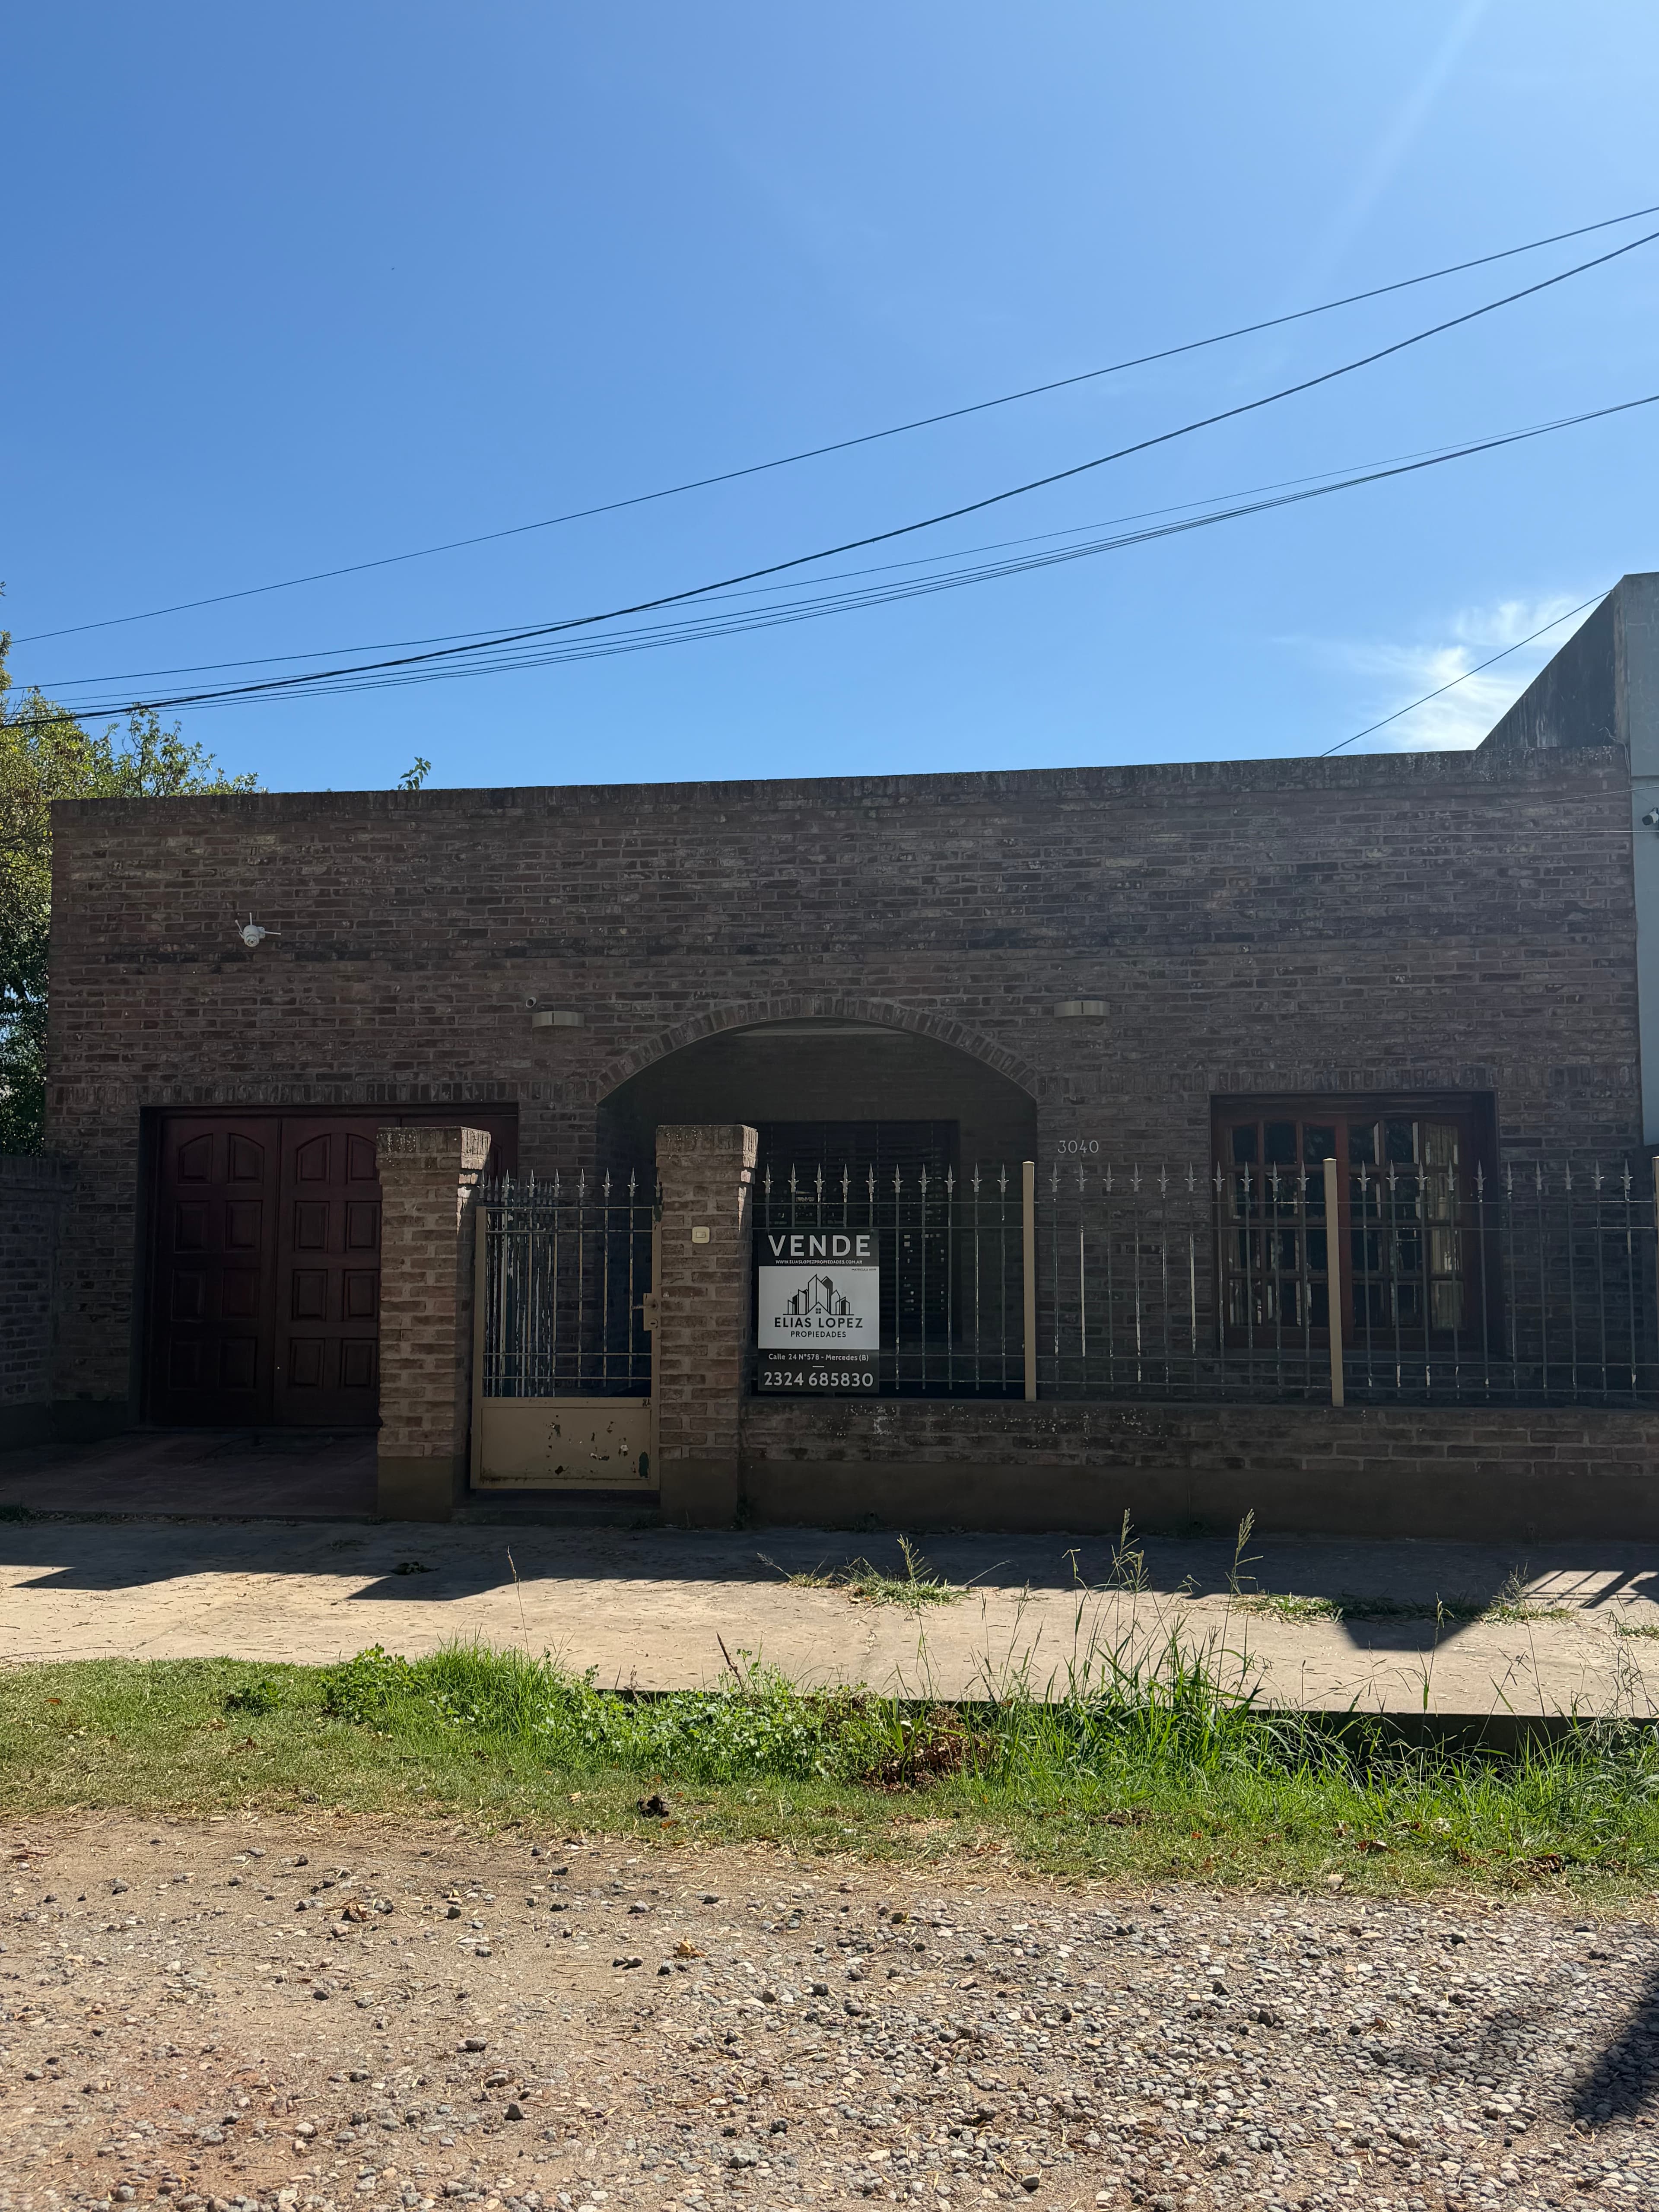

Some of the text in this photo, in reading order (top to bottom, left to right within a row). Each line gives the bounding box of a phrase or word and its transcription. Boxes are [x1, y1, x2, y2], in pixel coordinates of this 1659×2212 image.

[1058, 1140, 1099, 1154] 3040
[768, 1235, 871, 1257] VENDE
[774, 1317, 863, 1328] ELIAS LOPEZ
[764, 1371, 874, 1387] 2324 685830
